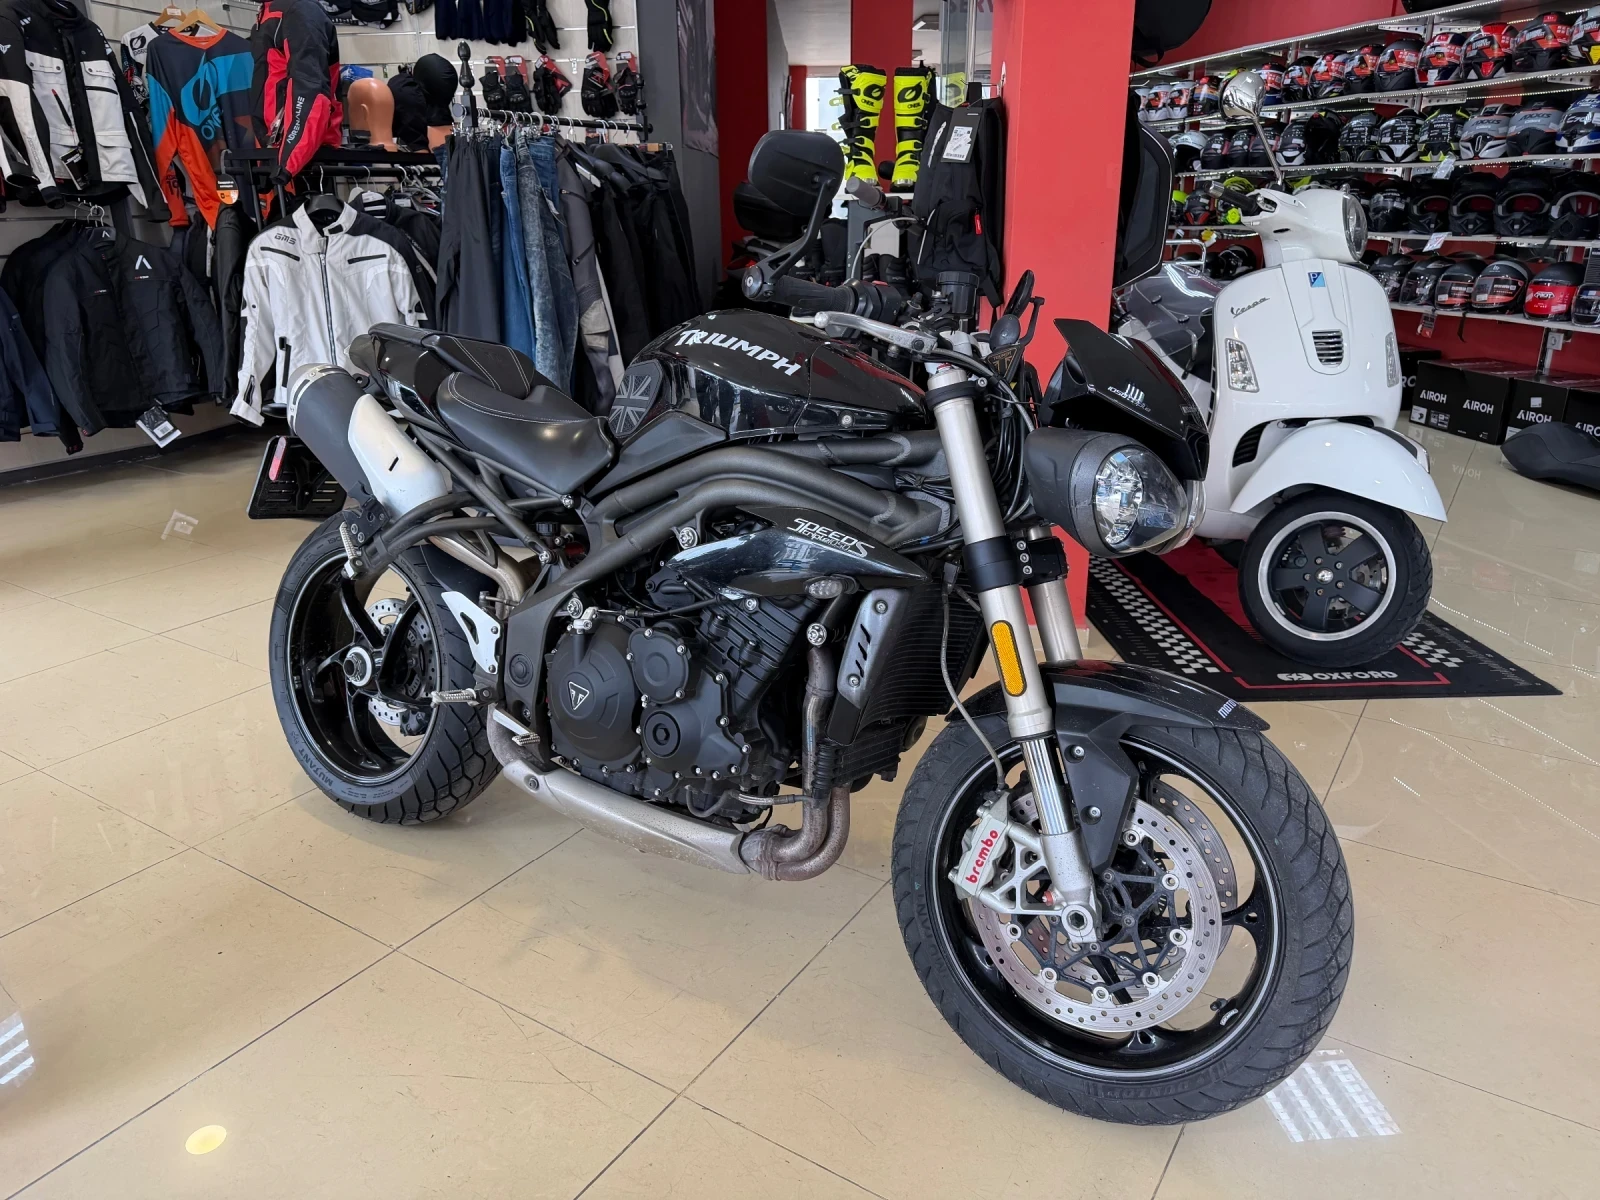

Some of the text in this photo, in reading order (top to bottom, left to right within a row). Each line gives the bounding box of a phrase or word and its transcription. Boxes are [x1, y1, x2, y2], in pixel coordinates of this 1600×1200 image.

[1519, 112, 1552, 121] AXXIS
[274, 232, 297, 246] GMS
[1230, 297, 1270, 319] Vespa
[674, 329, 802, 376] TRIUMPH
[1419, 389, 1447, 404] AIROH
[1462, 399, 1495, 415] AIROH
[1516, 409, 1552, 424] AIROH
[1574, 421, 1600, 437] AIRO
[1312, 670, 1399, 681] OXFORD
[298, 747, 334, 788] MUTANT
[965, 829, 999, 884] brembo
